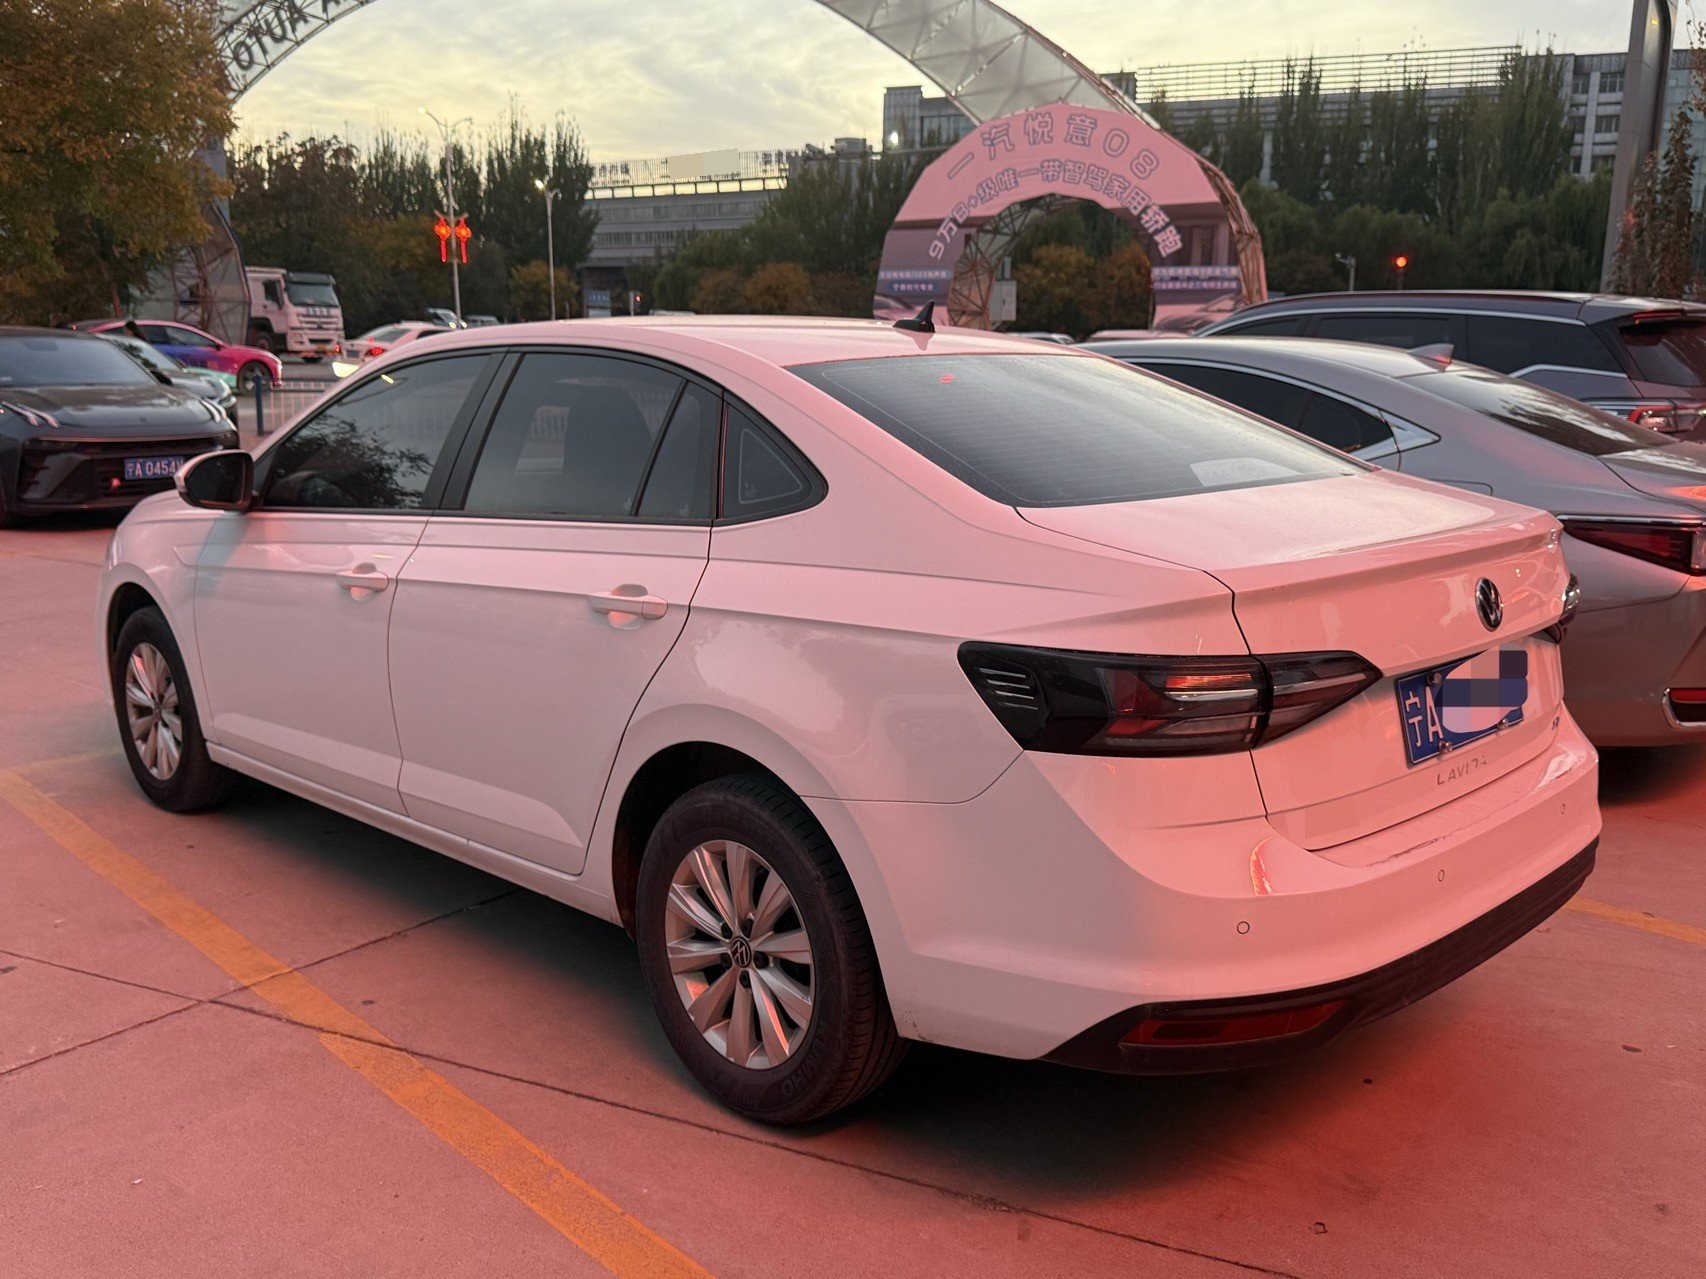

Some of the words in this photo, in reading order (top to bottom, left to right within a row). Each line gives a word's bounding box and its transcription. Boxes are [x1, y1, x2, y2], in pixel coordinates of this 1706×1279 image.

[947, 112, 1159, 180] 一汽悦意08
[1436, 755, 1488, 786] LAVI
